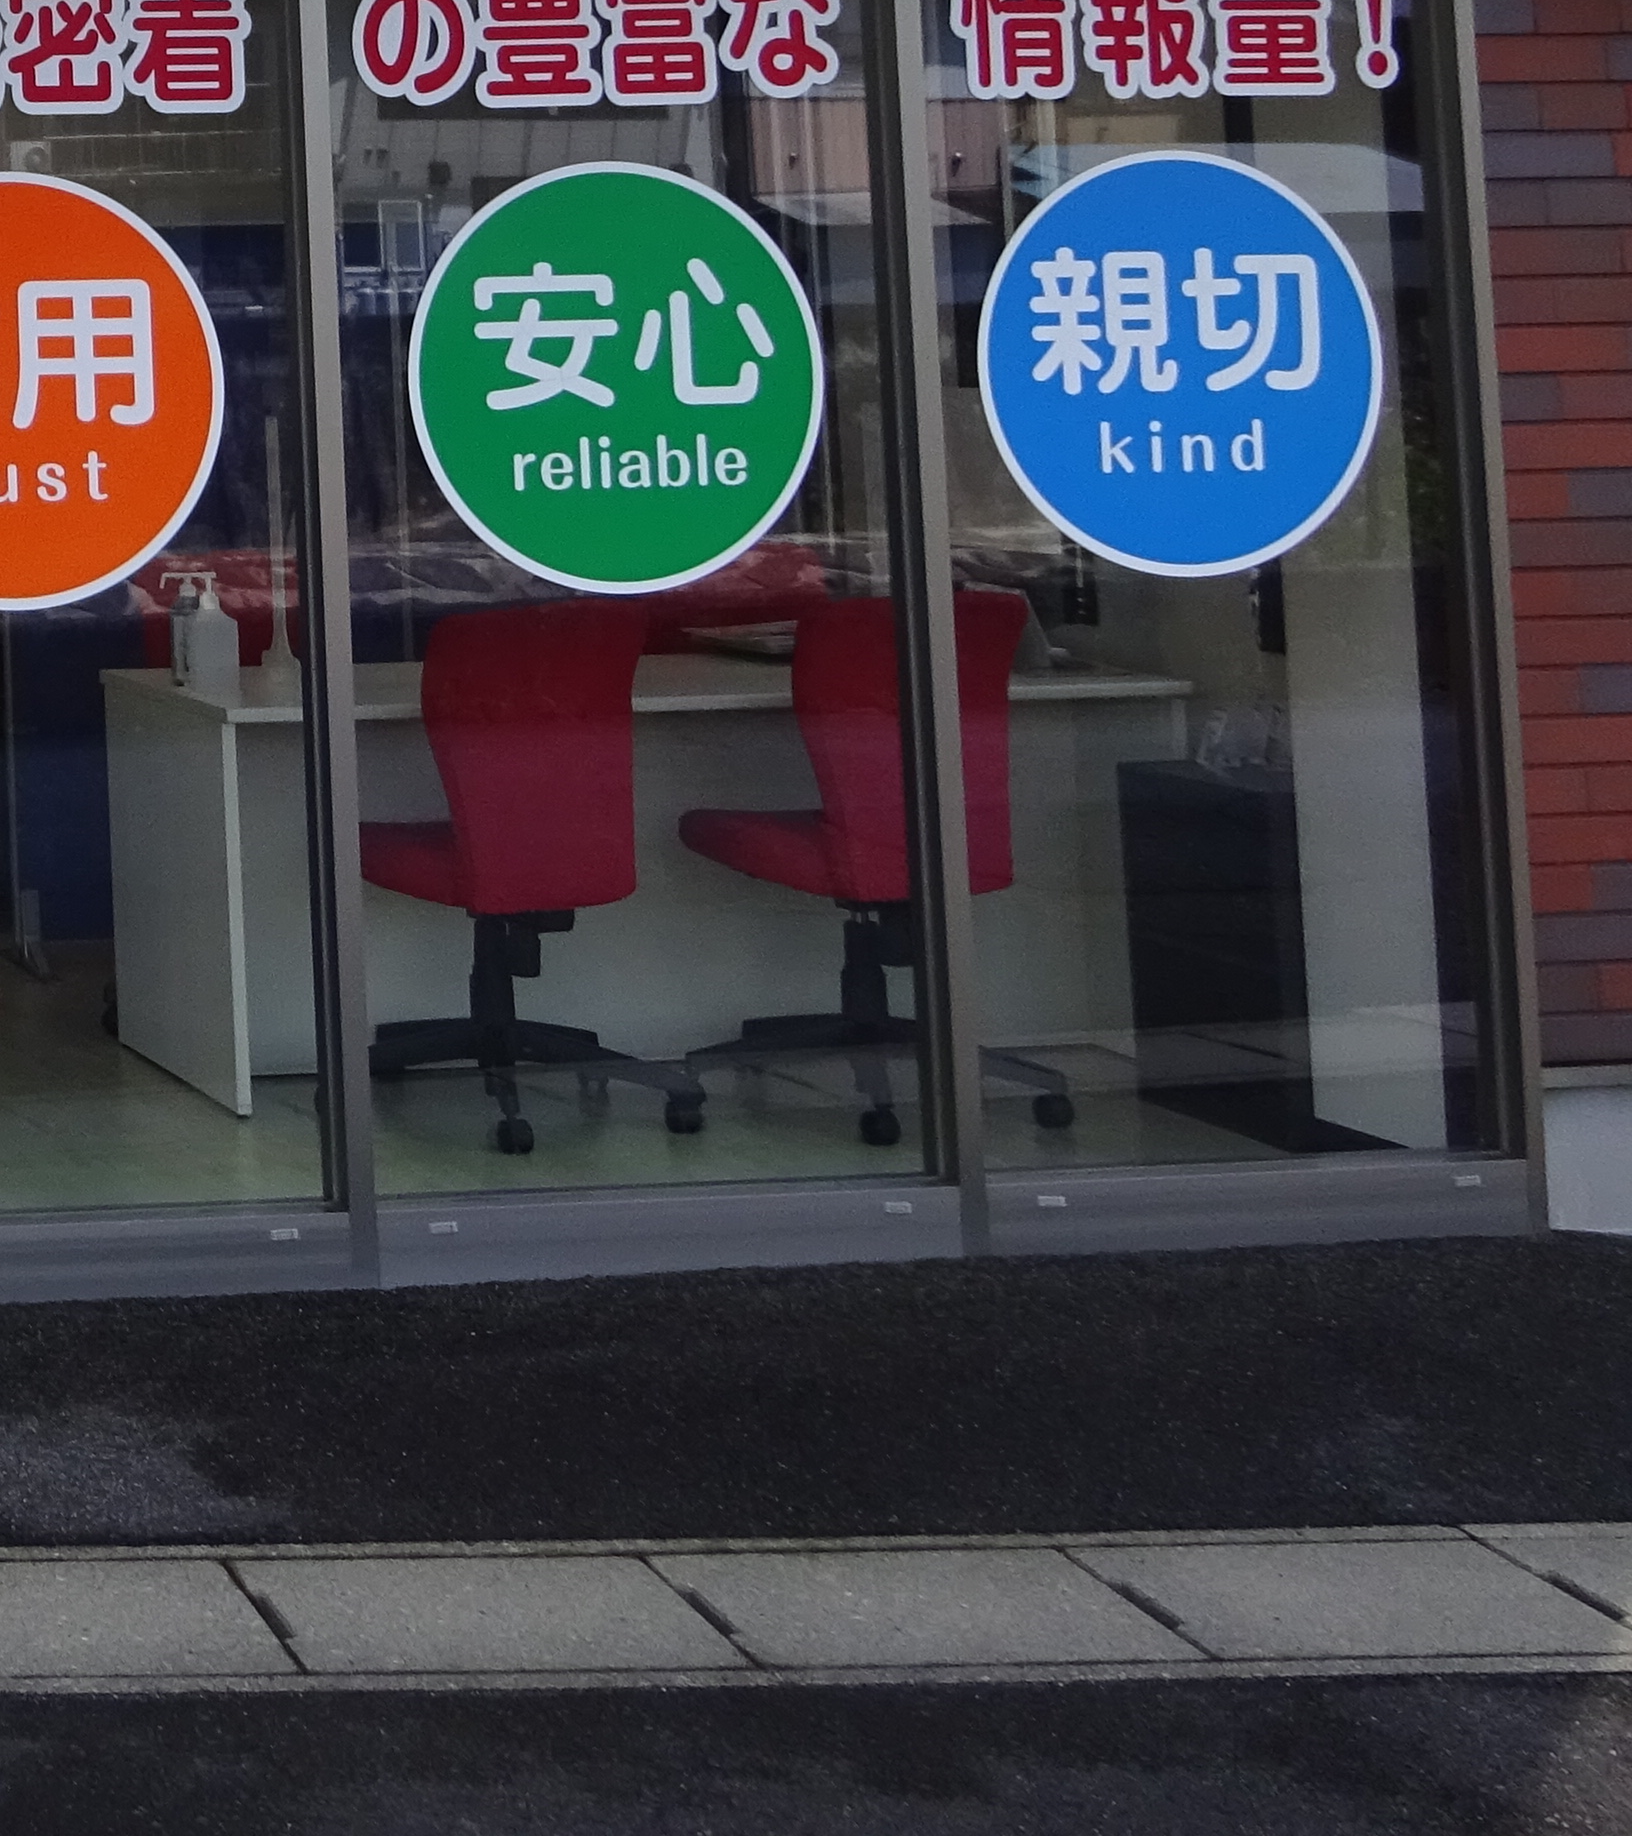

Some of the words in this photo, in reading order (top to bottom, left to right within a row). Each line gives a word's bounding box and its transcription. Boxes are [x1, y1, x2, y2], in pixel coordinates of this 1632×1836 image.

[472, 257, 776, 413] 安心
[1029, 246, 1321, 397] 親切
[511, 434, 749, 491] reliable
[1099, 418, 1265, 475] kind
